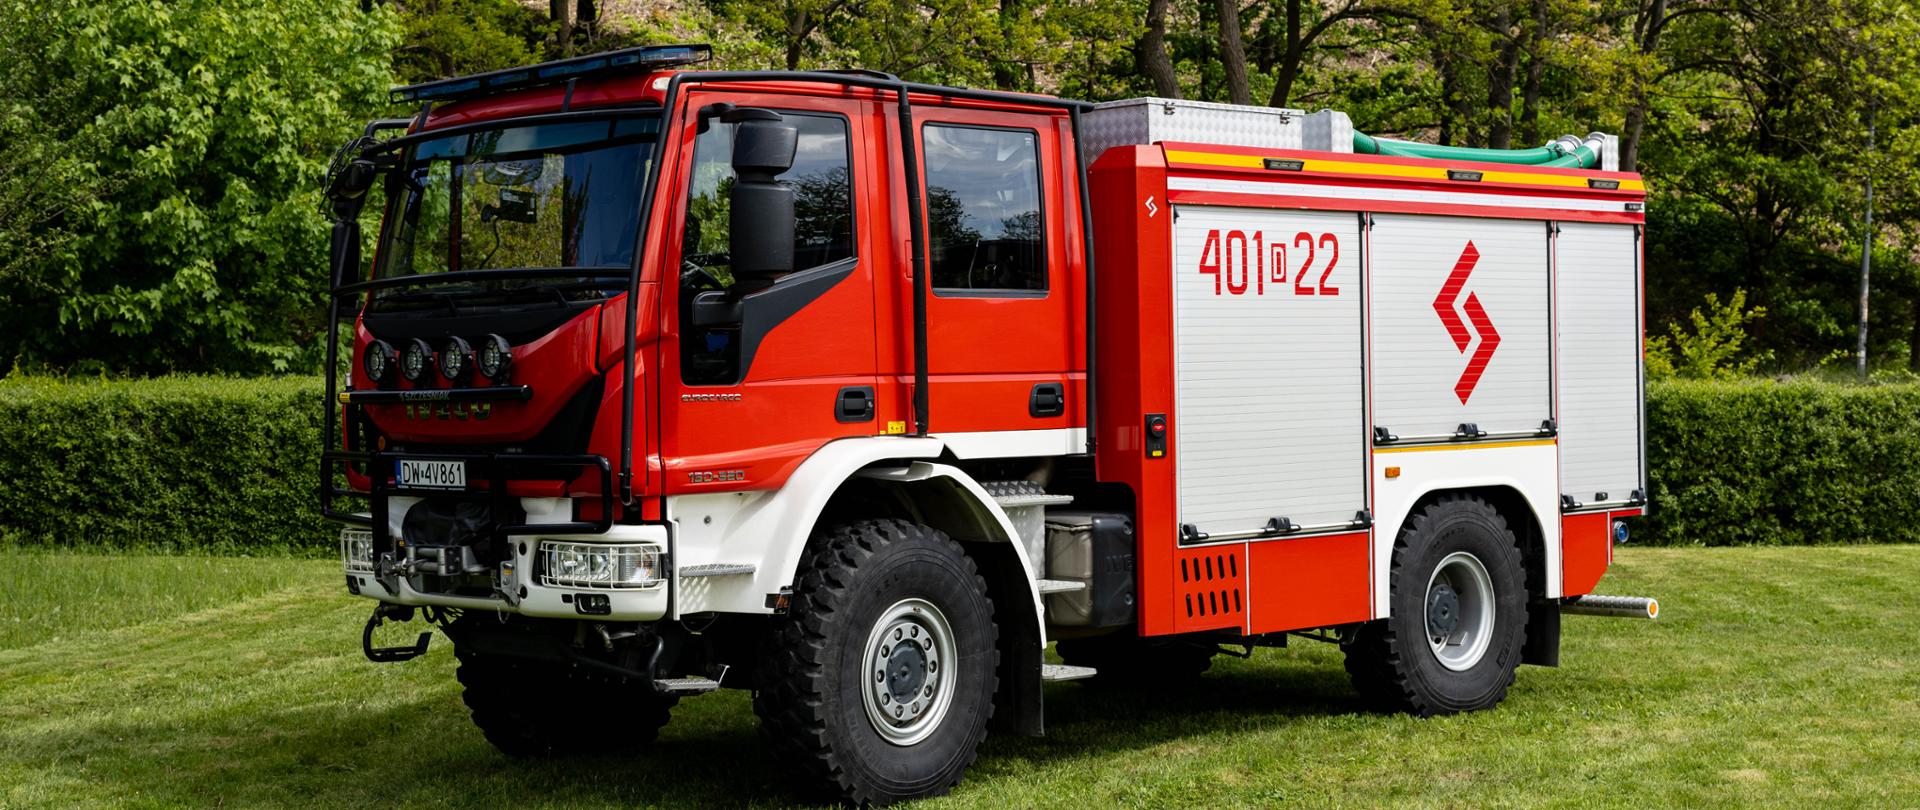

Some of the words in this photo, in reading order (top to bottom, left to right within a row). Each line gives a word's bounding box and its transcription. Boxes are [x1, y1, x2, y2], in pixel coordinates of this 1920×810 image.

[1200, 229, 1263, 295] 401
[1272, 245, 1285, 281] D
[1294, 232, 1339, 295] 22
